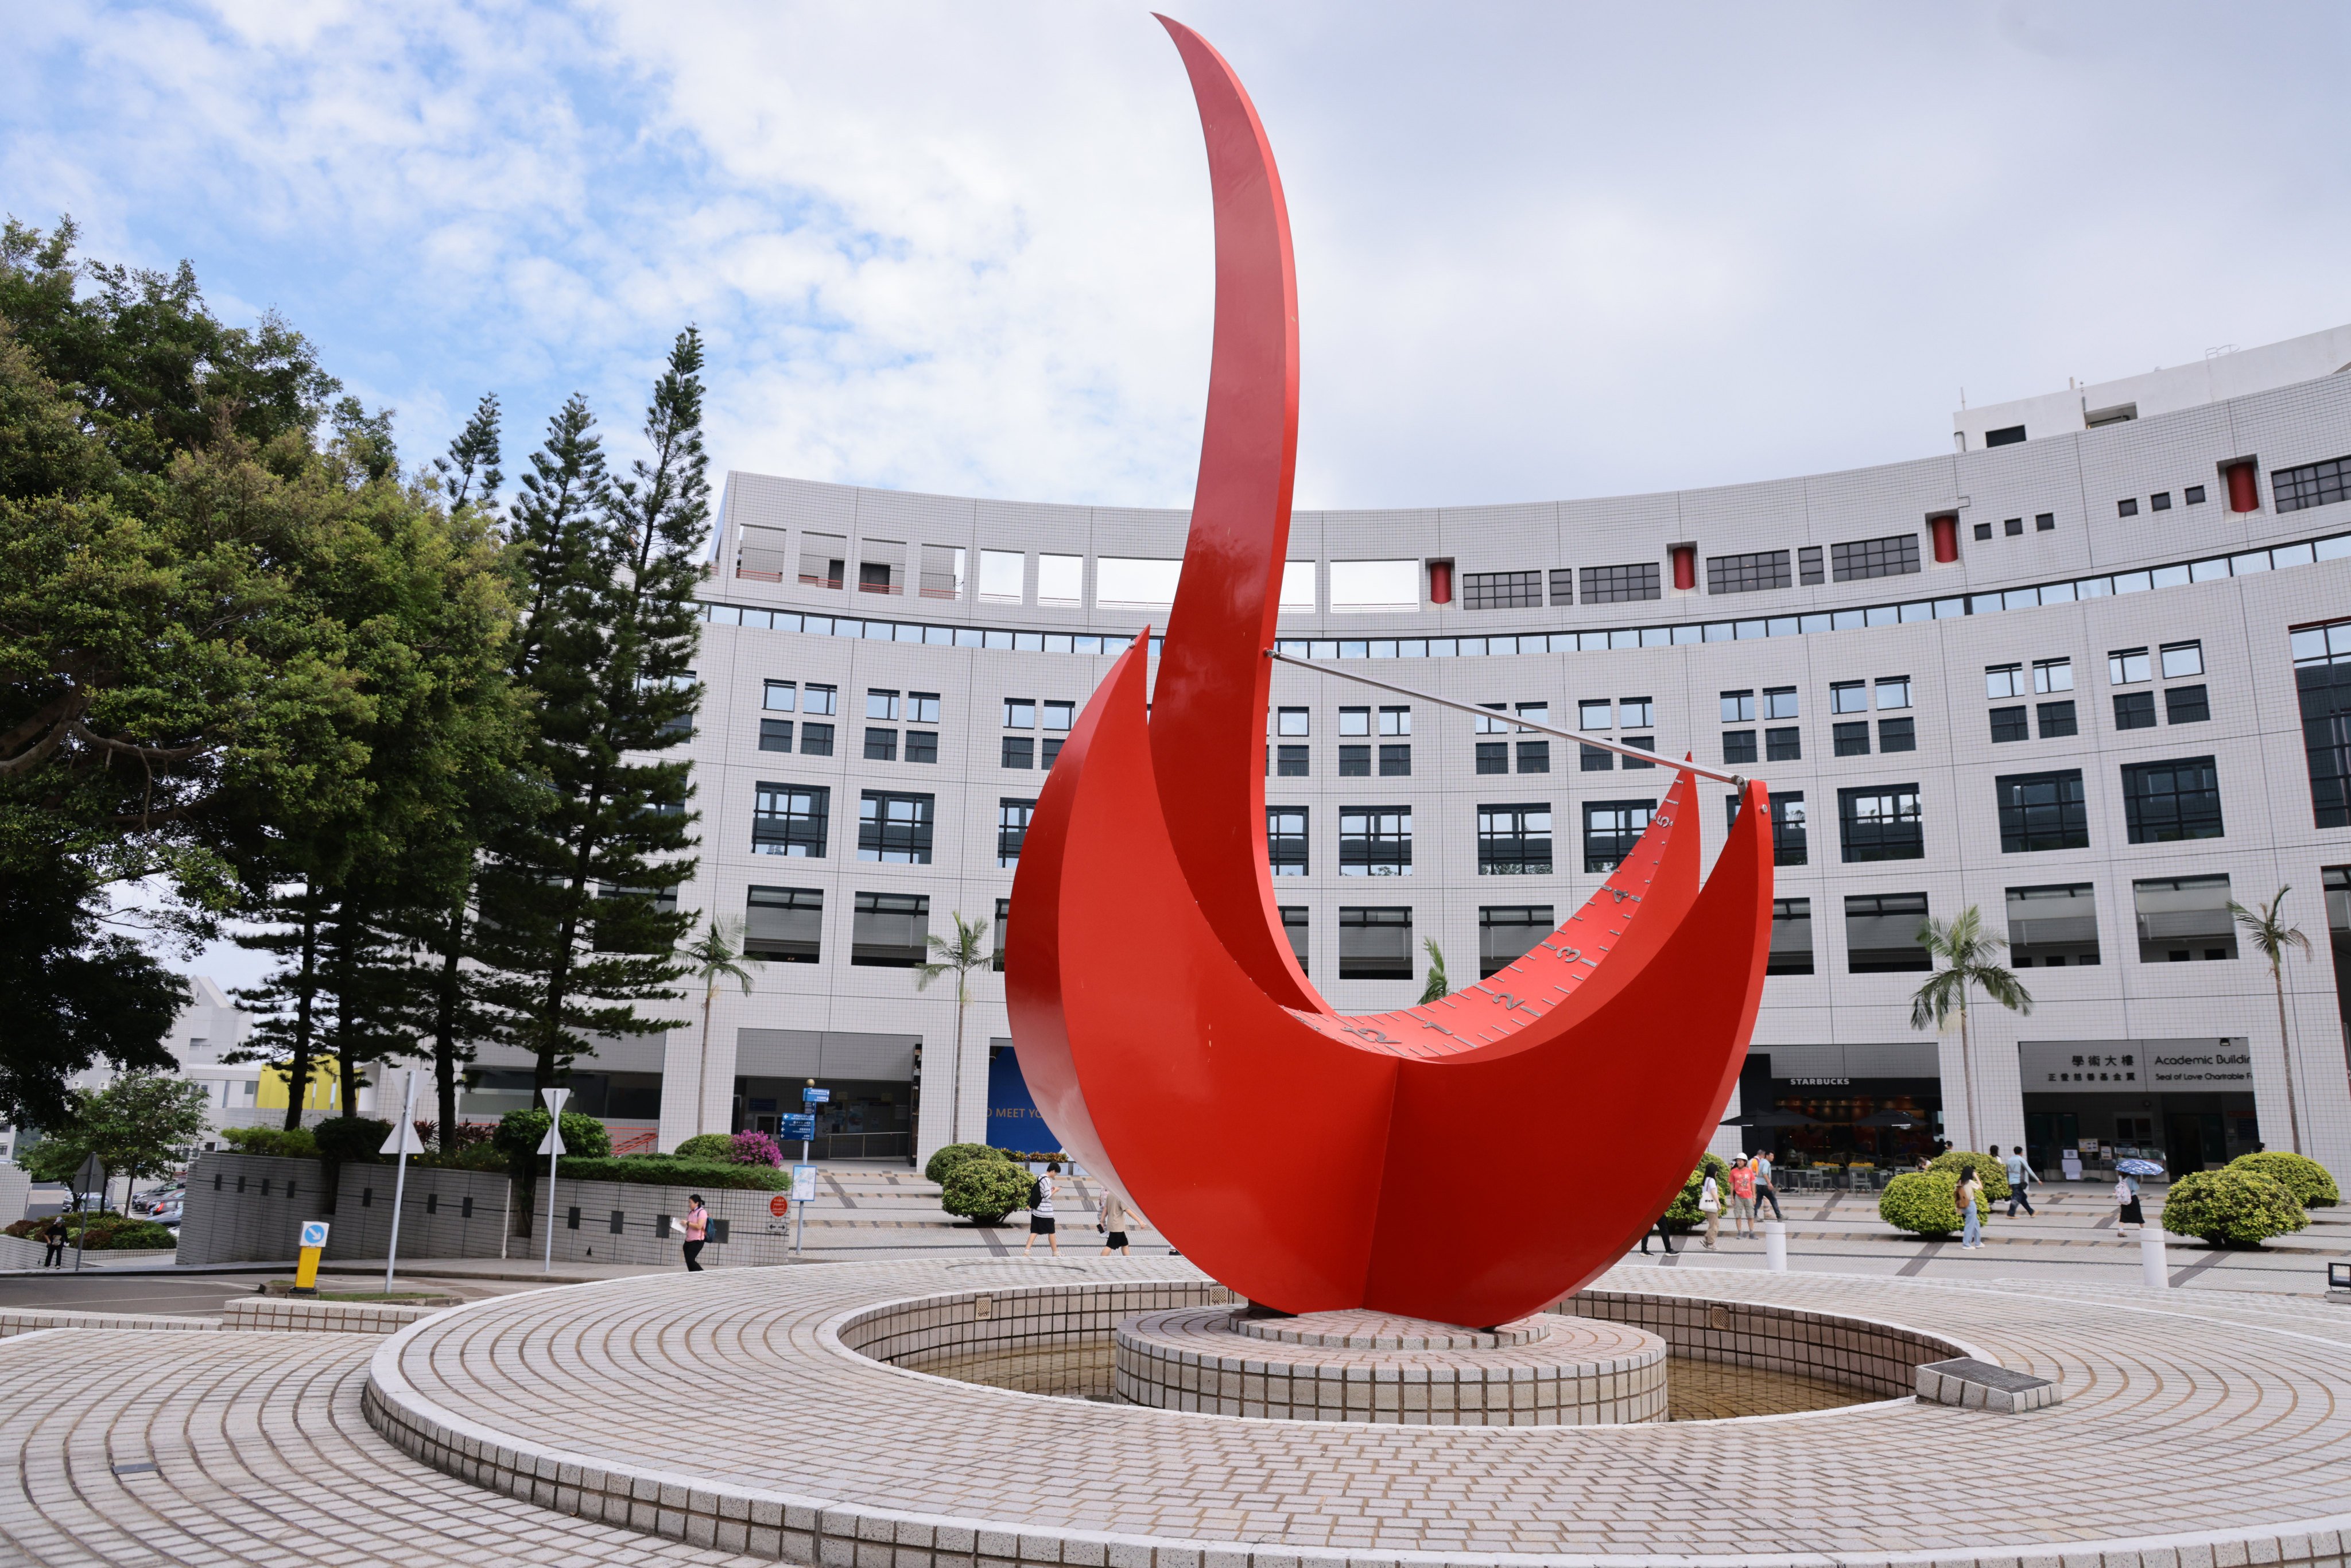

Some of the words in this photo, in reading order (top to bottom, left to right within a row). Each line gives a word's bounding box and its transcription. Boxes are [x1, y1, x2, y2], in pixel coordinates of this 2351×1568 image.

[1656, 815, 1670, 828] 5
[1613, 889, 1629, 903] 4
[1556, 946, 1581, 962] 3
[1492, 992, 1525, 1010] 2
[1422, 1021, 1453, 1035] 1
[1341, 1027, 1402, 1043] 12
[2071, 1054, 2134, 1067] 學術大樓
[2155, 1055, 2213, 1065] Academic
[2204, 1072, 2245, 1080] Charitable
[996, 1108, 1026, 1118] MEET
